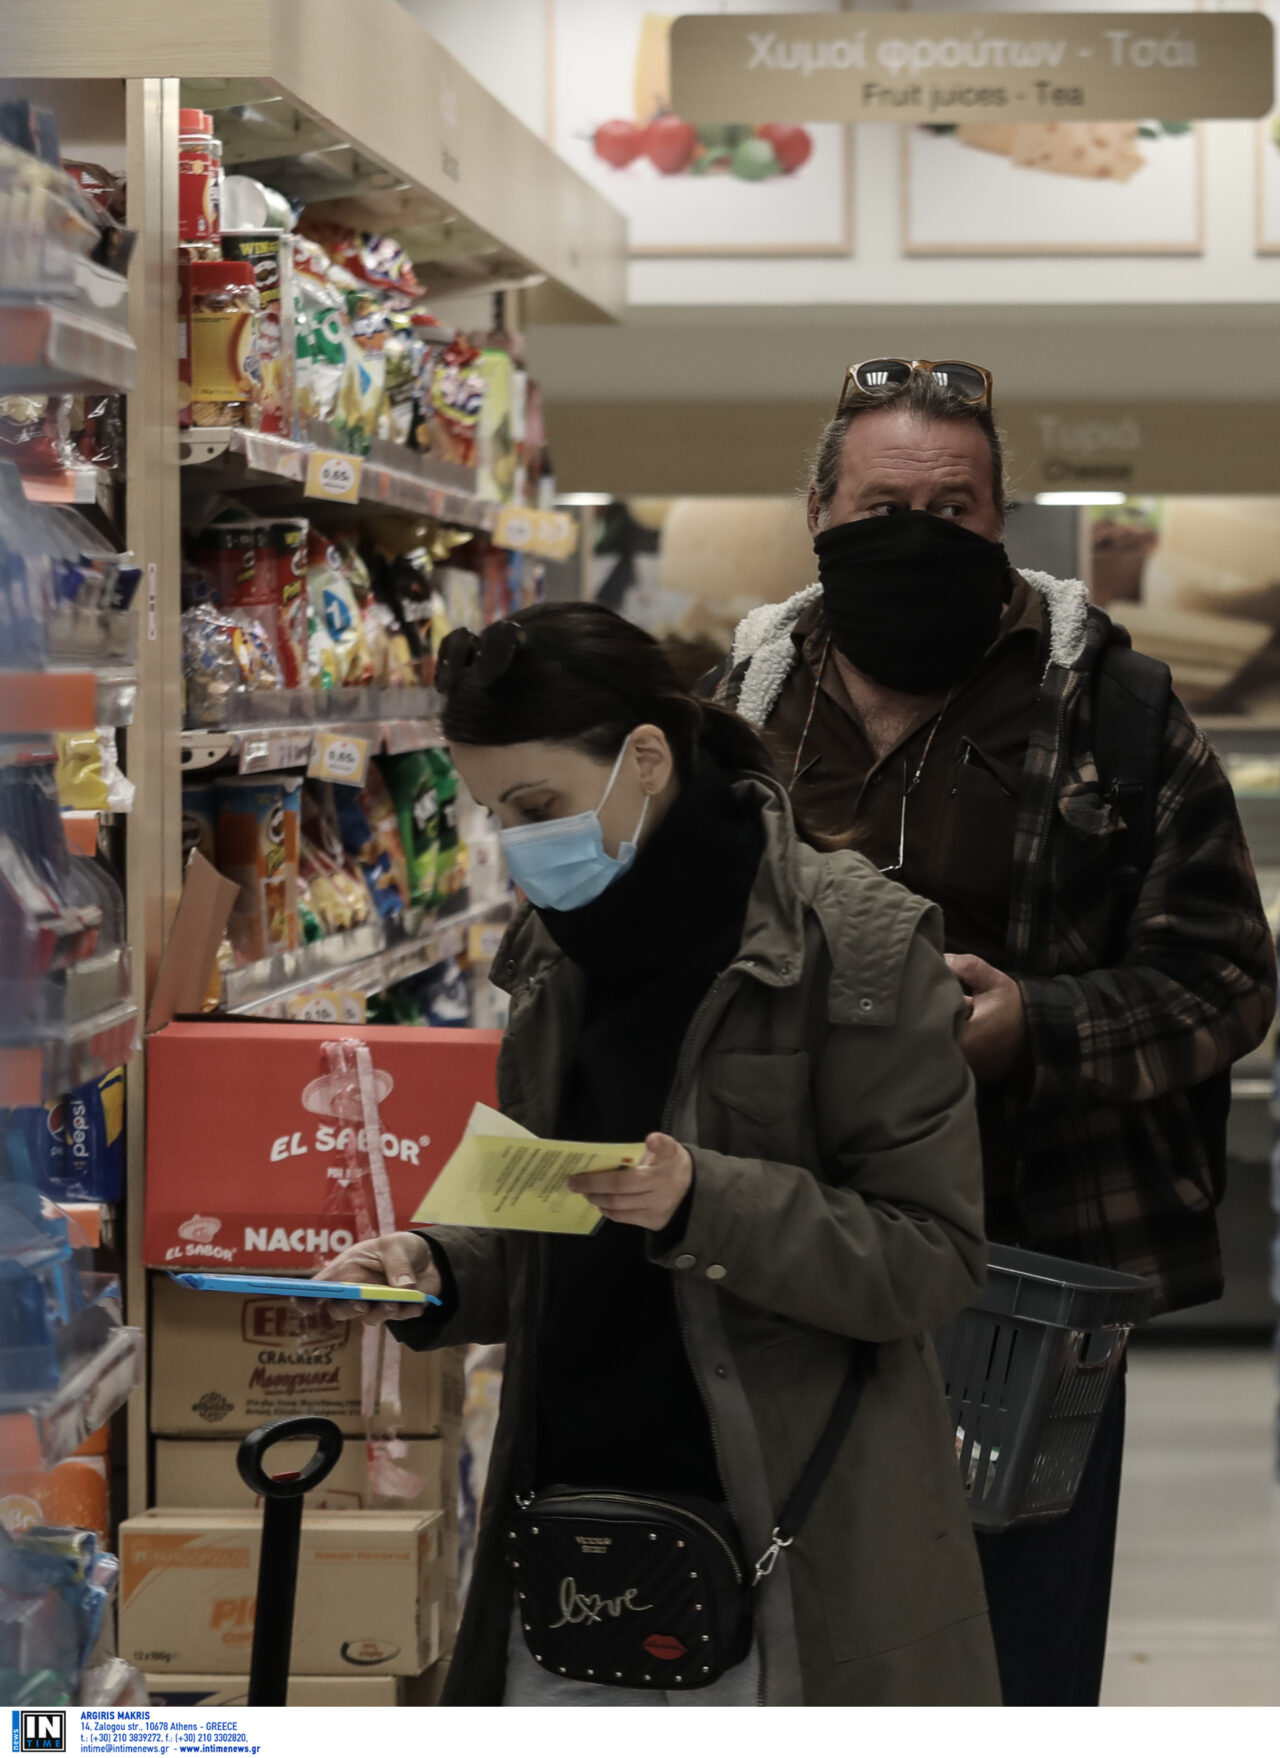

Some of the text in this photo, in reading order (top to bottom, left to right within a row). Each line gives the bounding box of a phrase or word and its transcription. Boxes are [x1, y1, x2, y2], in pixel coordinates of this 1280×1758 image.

[745, 29, 867, 77] Χυμοί
[877, 31, 1067, 77] φρούτων
[1105, 30, 1198, 68] Τσάι
[861, 81, 922, 106] Fruit
[929, 81, 1007, 112] juices
[1033, 80, 1085, 106] Tea
[72, 1101, 90, 1157] pepsi
[270, 1132, 308, 1162] EL
[165, 1245, 184, 1261] EL
[549, 1576, 653, 1629] love
